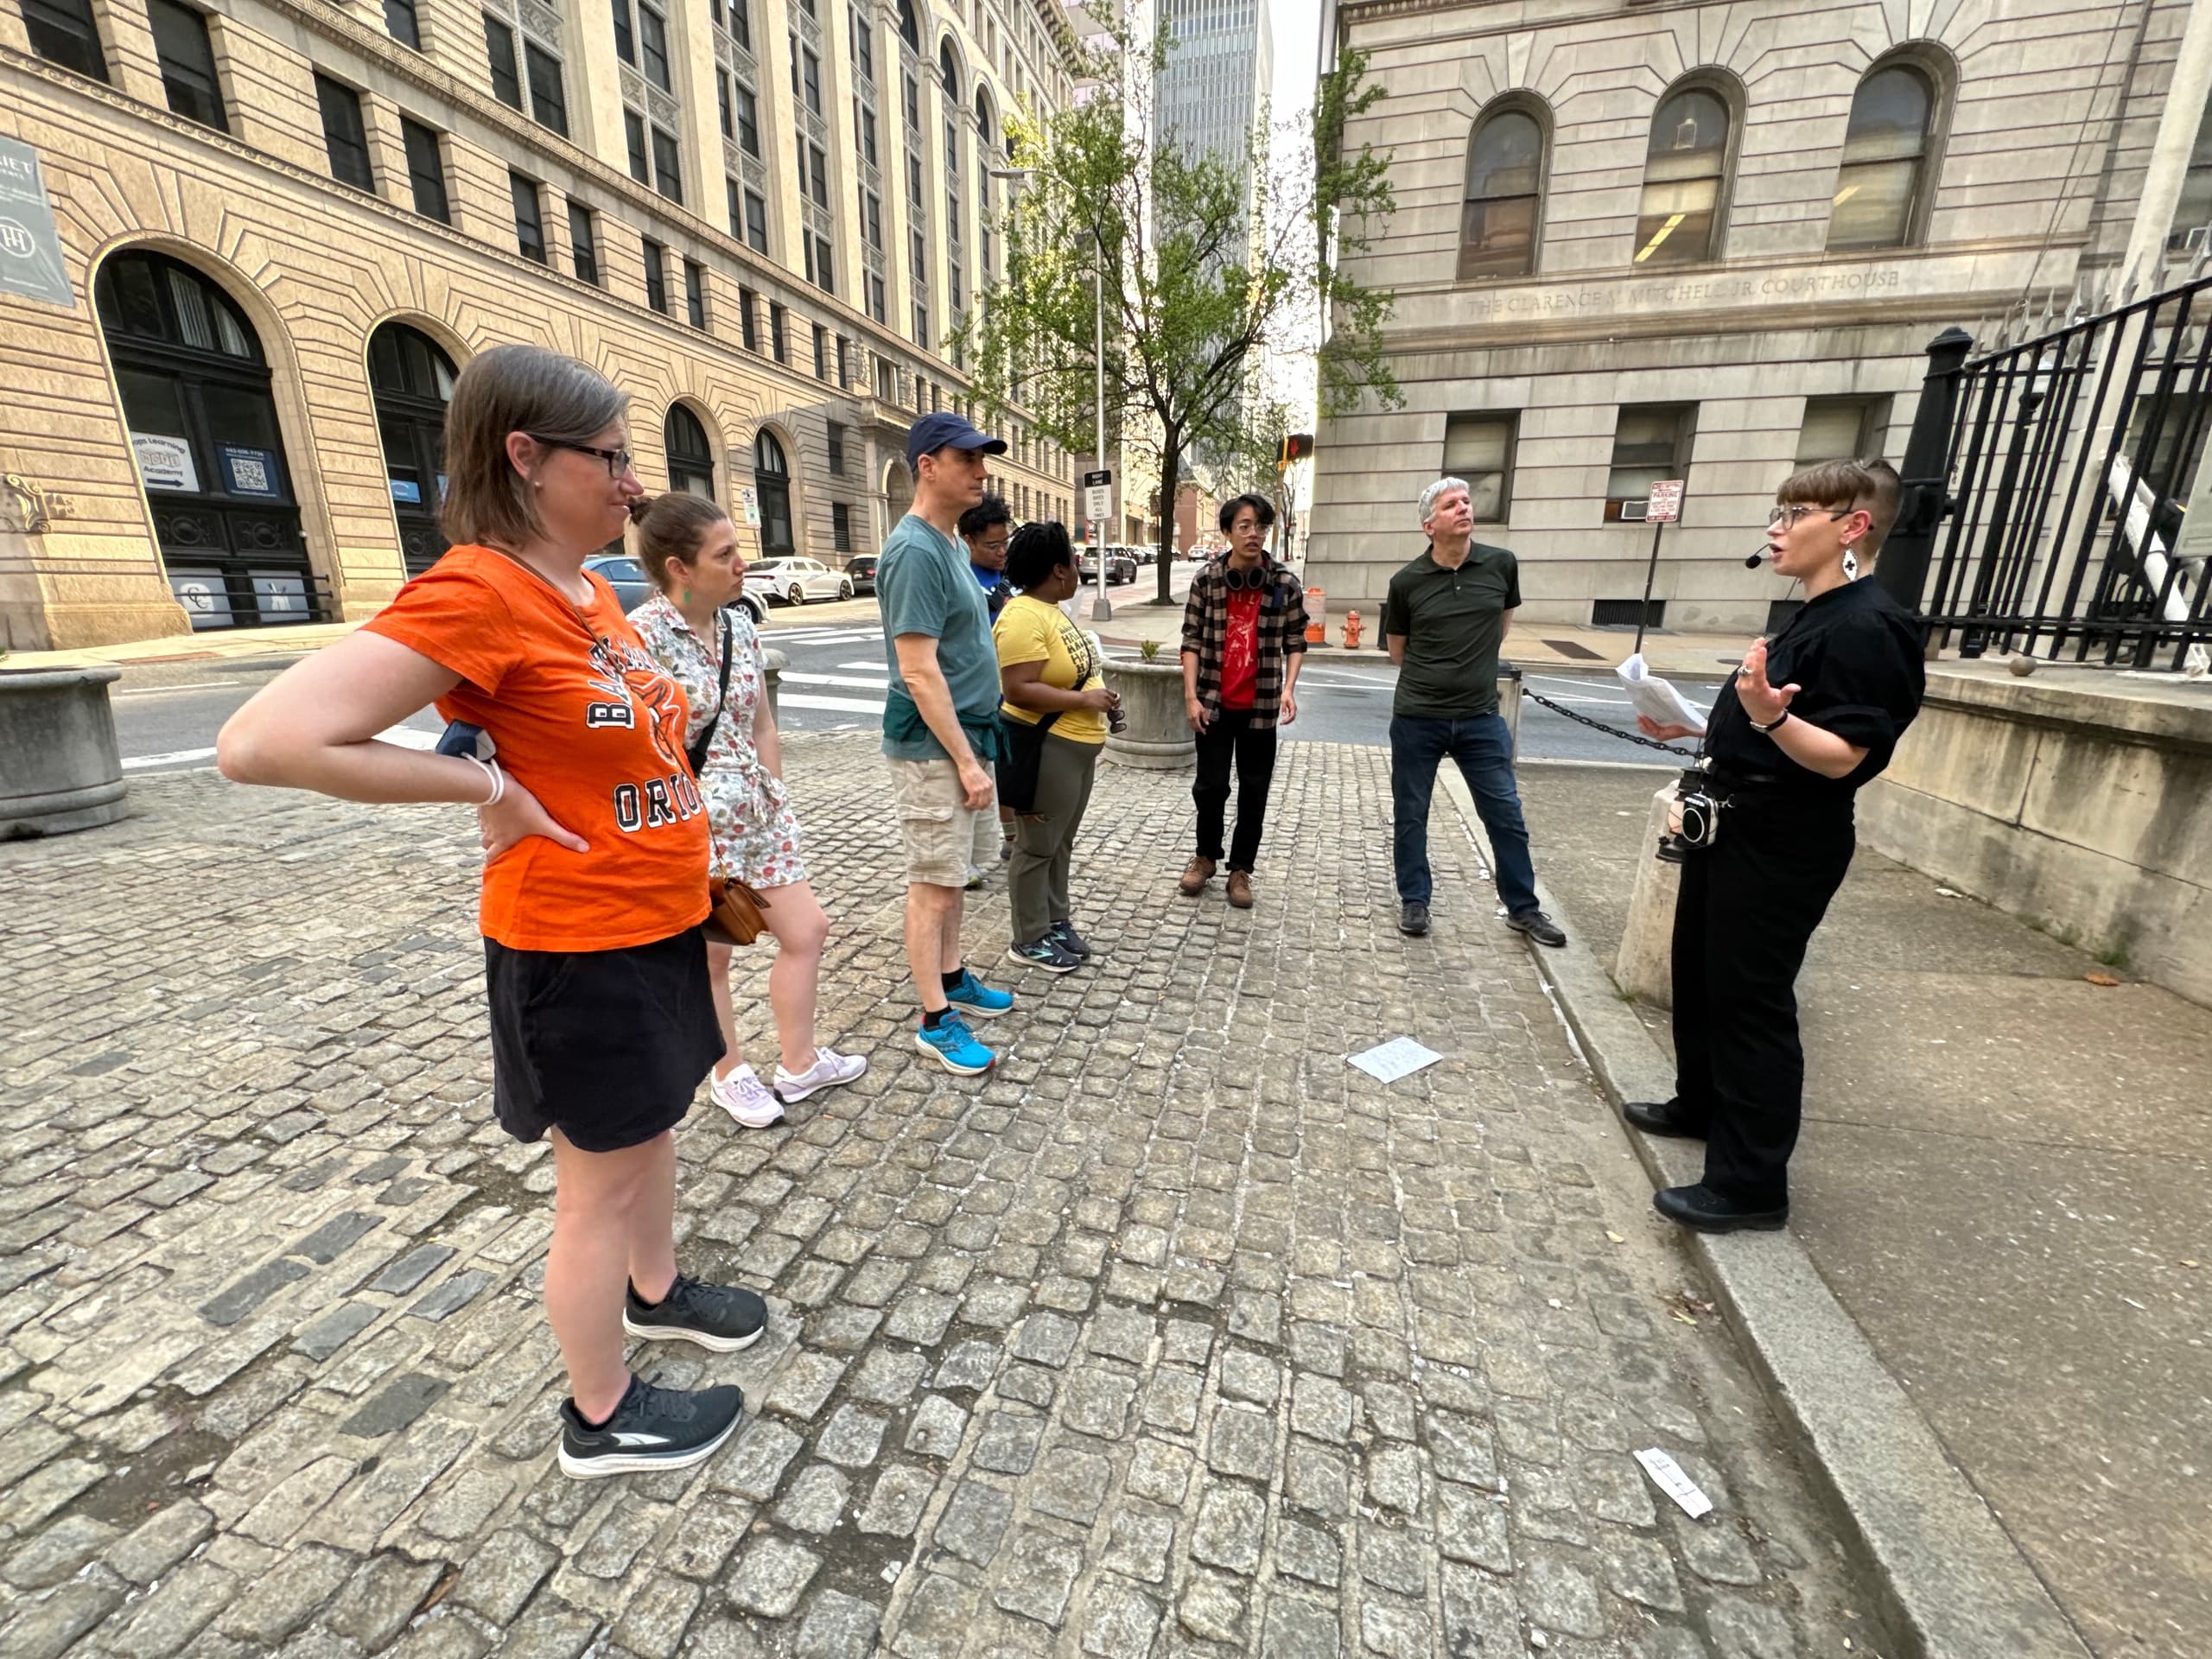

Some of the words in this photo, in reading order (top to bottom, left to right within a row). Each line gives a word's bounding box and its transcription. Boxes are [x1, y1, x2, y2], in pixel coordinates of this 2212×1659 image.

[0, 154, 32, 174] IET
[1468, 298, 1502, 315] THE
[1506, 289, 1605, 313] CLARENCE
[1761, 270, 1900, 295] COURTHOUSE
[148, 437, 186, 454] Learning
[143, 465, 183, 477] Academy
[613, 772, 703, 833] ORIO
